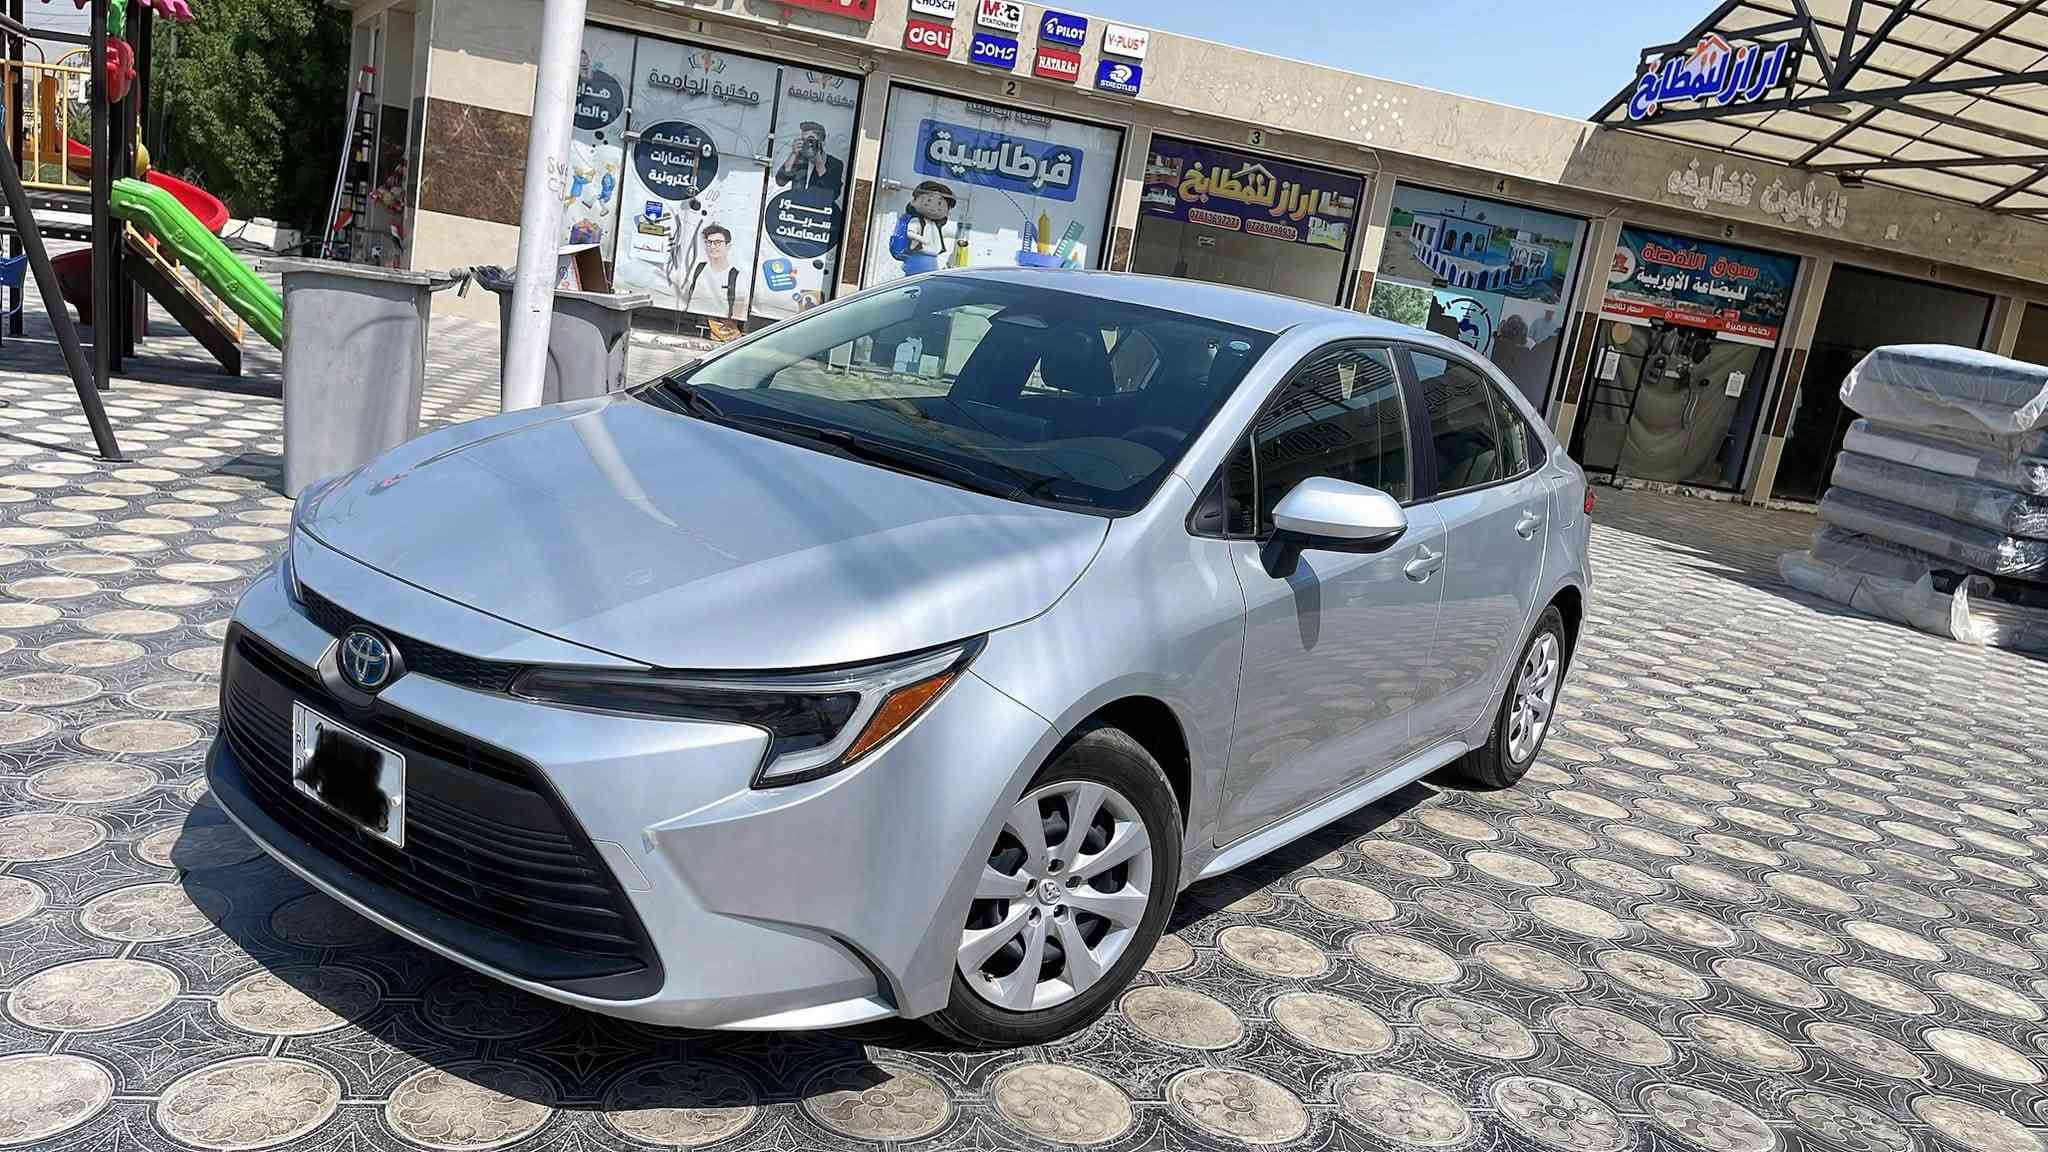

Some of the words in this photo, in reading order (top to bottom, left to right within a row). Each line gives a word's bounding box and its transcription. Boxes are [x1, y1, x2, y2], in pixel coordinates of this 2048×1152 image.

[983, 0, 1020, 22] M&G
[981, 17, 1019, 29] STATIONERY
[909, 27, 951, 49] deli
[1056, 26, 1085, 40] PILOT
[975, 41, 1016, 60] DOMS
[1039, 56, 1079, 74] NATARAJ
[648, 69, 709, 97] الجامعة
[1006, 81, 1016, 96] 2
[712, 80, 760, 105] مكتبة
[1251, 131, 1261, 145] 3
[929, 130, 1073, 188] قرطاسية
[1496, 179, 1505, 193] 4
[779, 198, 833, 215] صور
[779, 210, 832, 229] سريعة
[776, 225, 831, 243] للمعاملات
[1724, 225, 1734, 237] 5
[1711, 257, 1760, 281] سوق
[1693, 277, 1748, 302] للبضاعة
